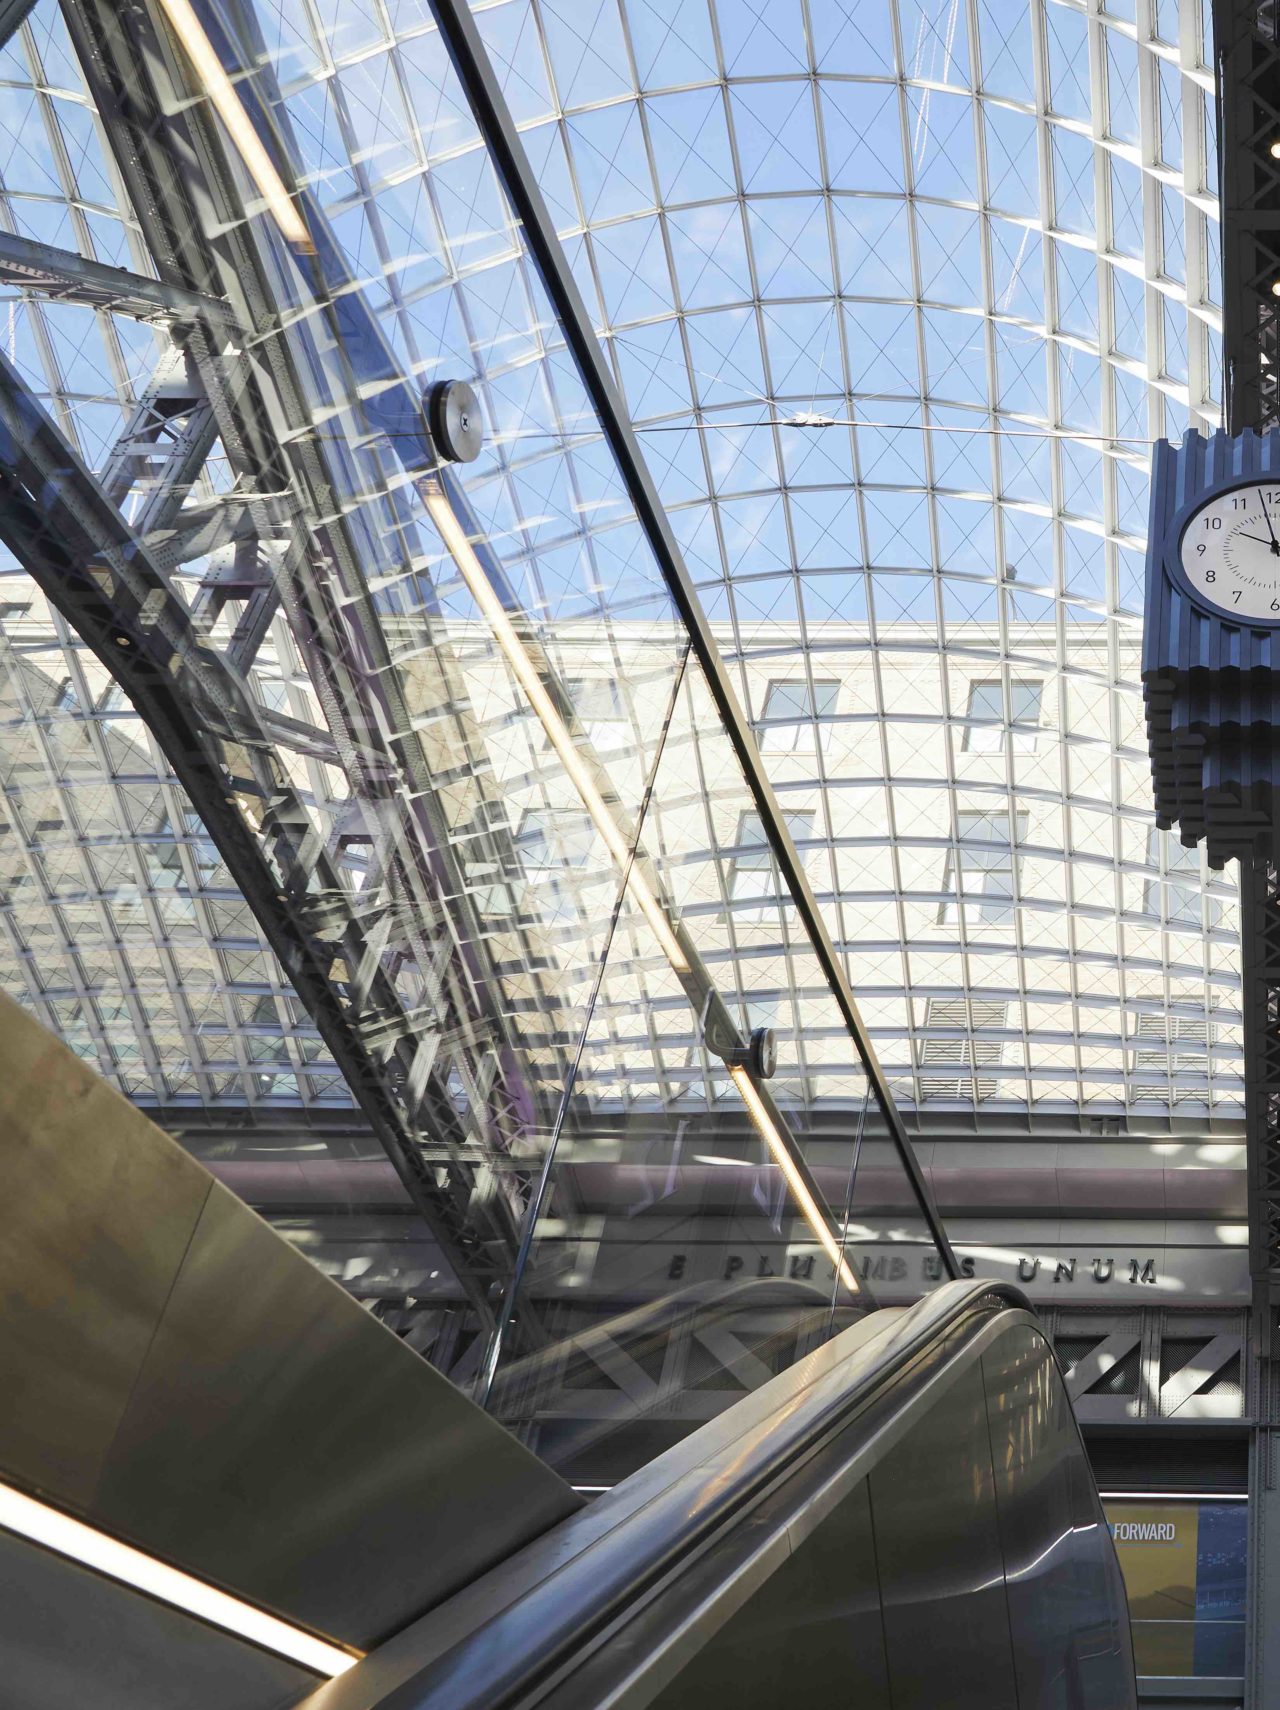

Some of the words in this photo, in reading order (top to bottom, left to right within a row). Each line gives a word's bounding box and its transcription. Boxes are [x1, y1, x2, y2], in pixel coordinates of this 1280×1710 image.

[1231, 498, 1247, 510] 11
[1203, 517, 1222, 530] 10
[1196, 544, 1207, 557] 9
[1205, 570, 1216, 583] 8
[1232, 590, 1243, 604] 7
[1270, 598, 1280, 611] 6
[1017, 1257, 1157, 1283] UNUM
[1113, 1522, 1176, 1541] FORWARD
